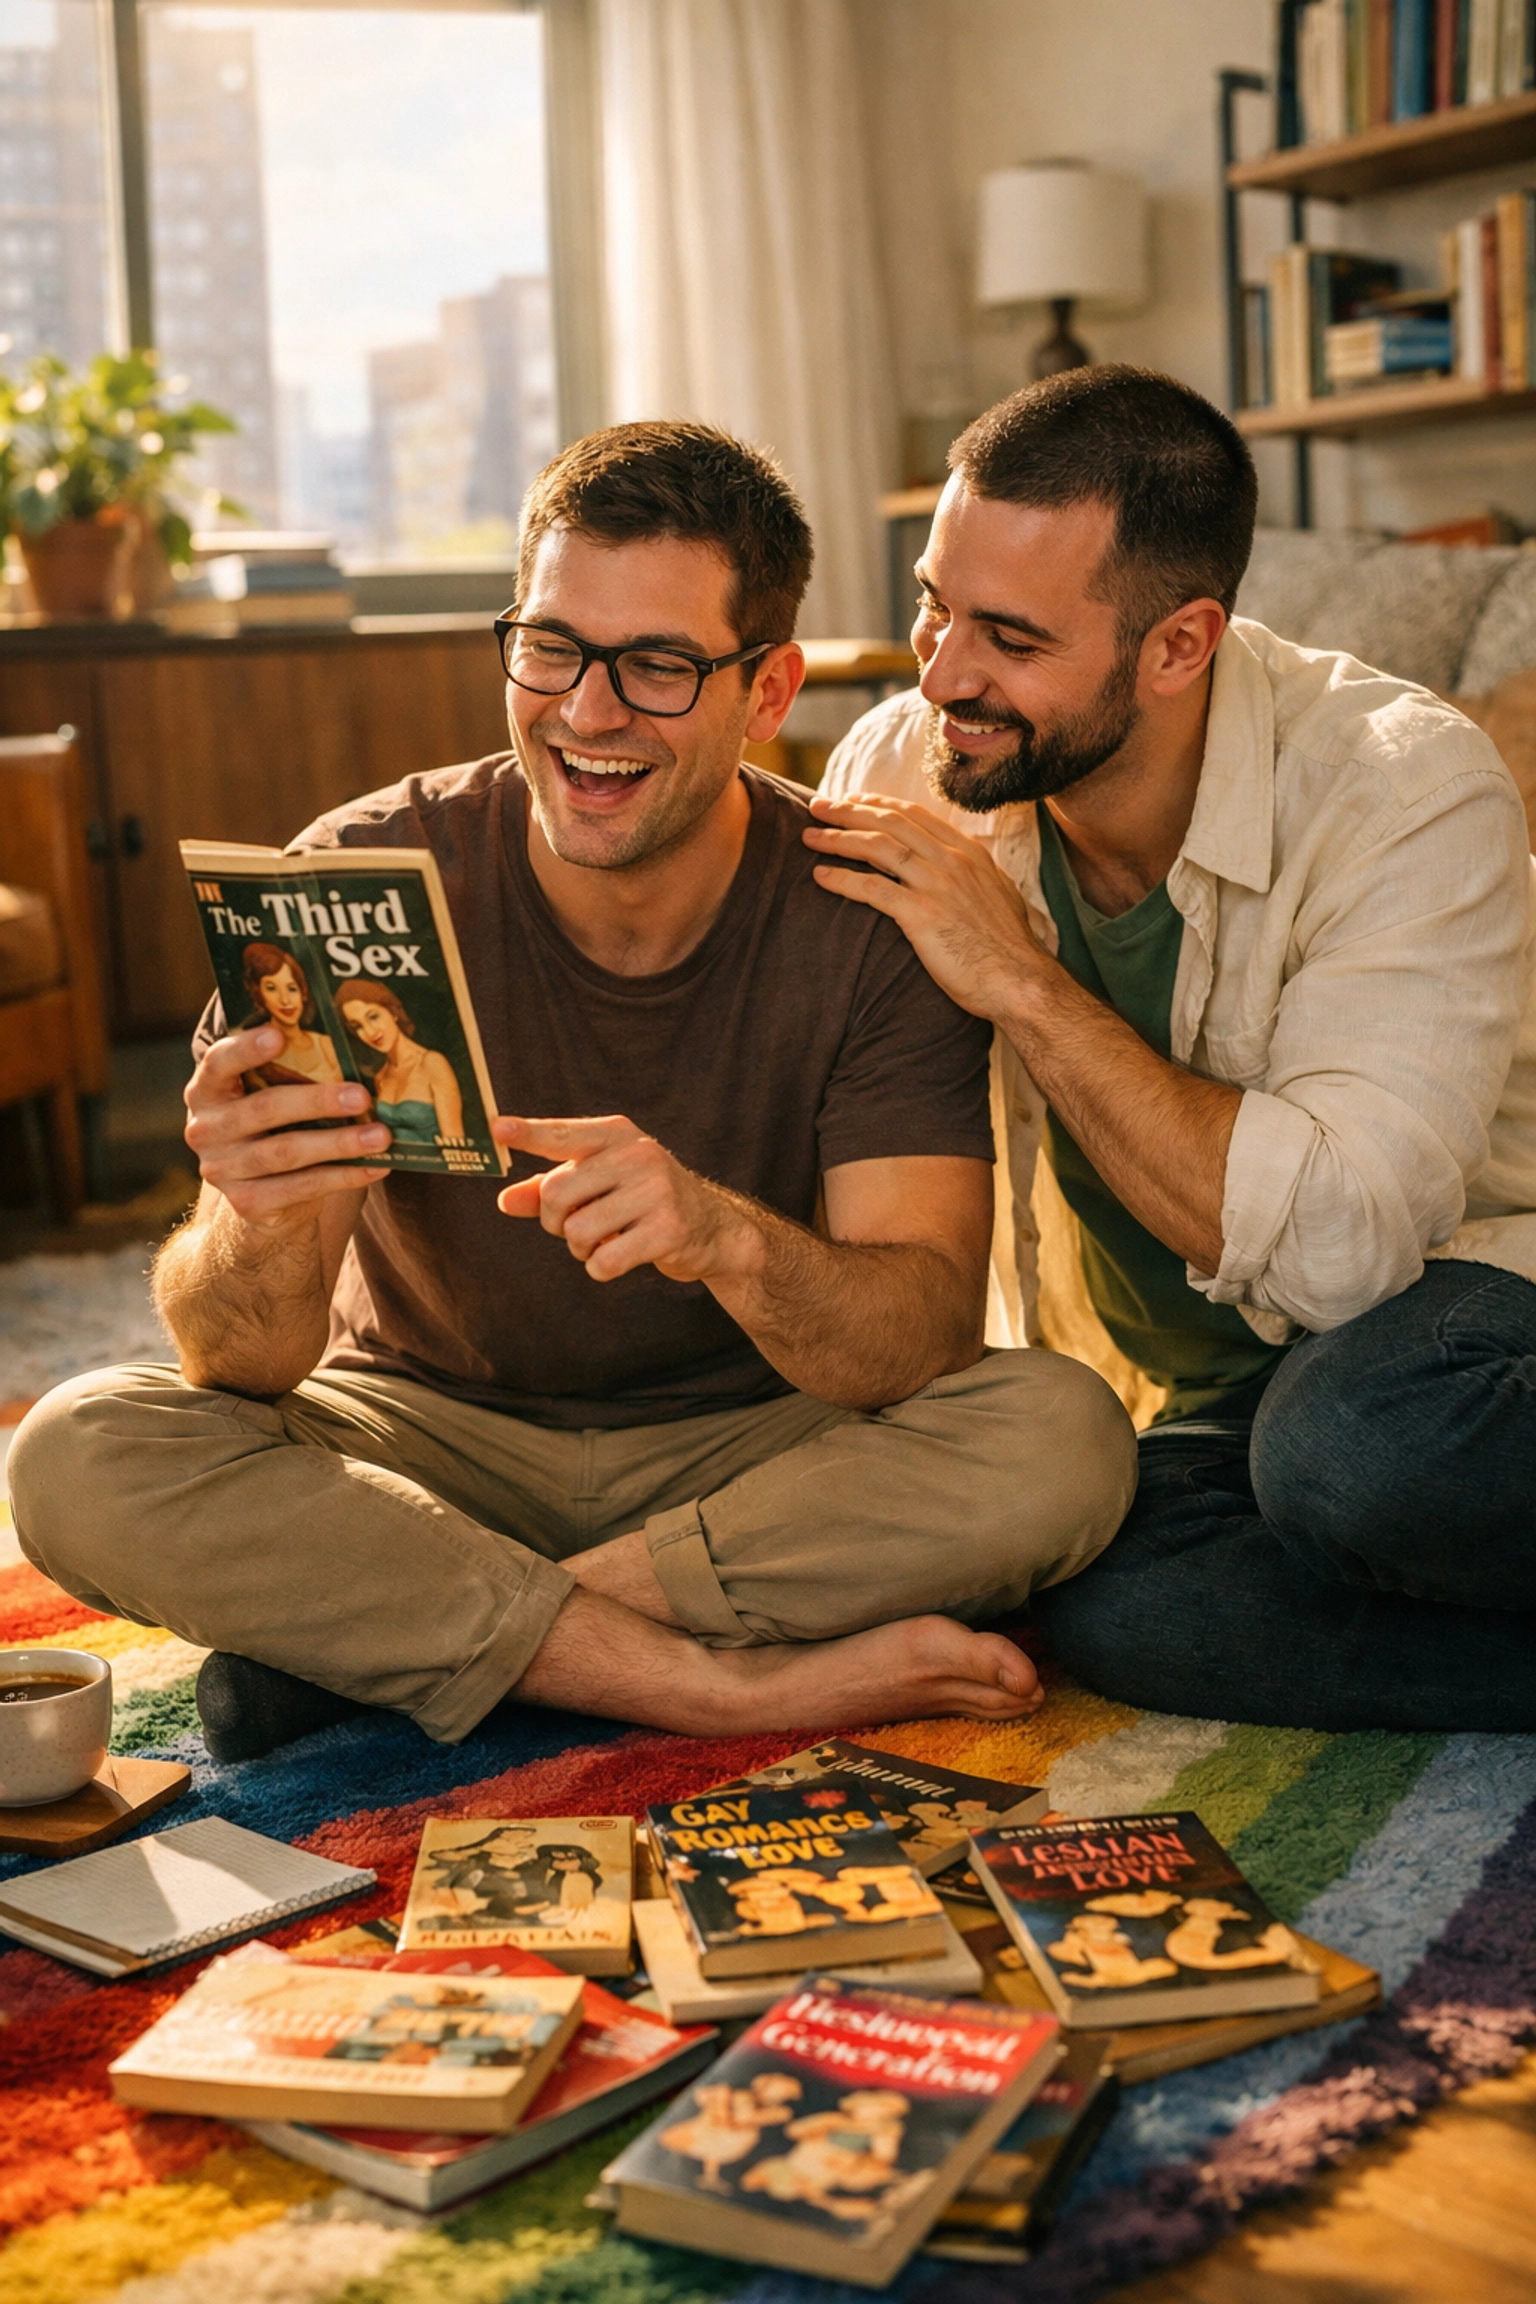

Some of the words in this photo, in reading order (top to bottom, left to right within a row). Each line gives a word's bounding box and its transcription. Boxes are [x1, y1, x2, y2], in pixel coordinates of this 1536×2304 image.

[207, 906, 263, 937] The
[260, 889, 411, 937] Third
[325, 935, 430, 978] Sex
[670, 1799, 750, 1827] GAY
[735, 1836, 845, 1870] LOVE
